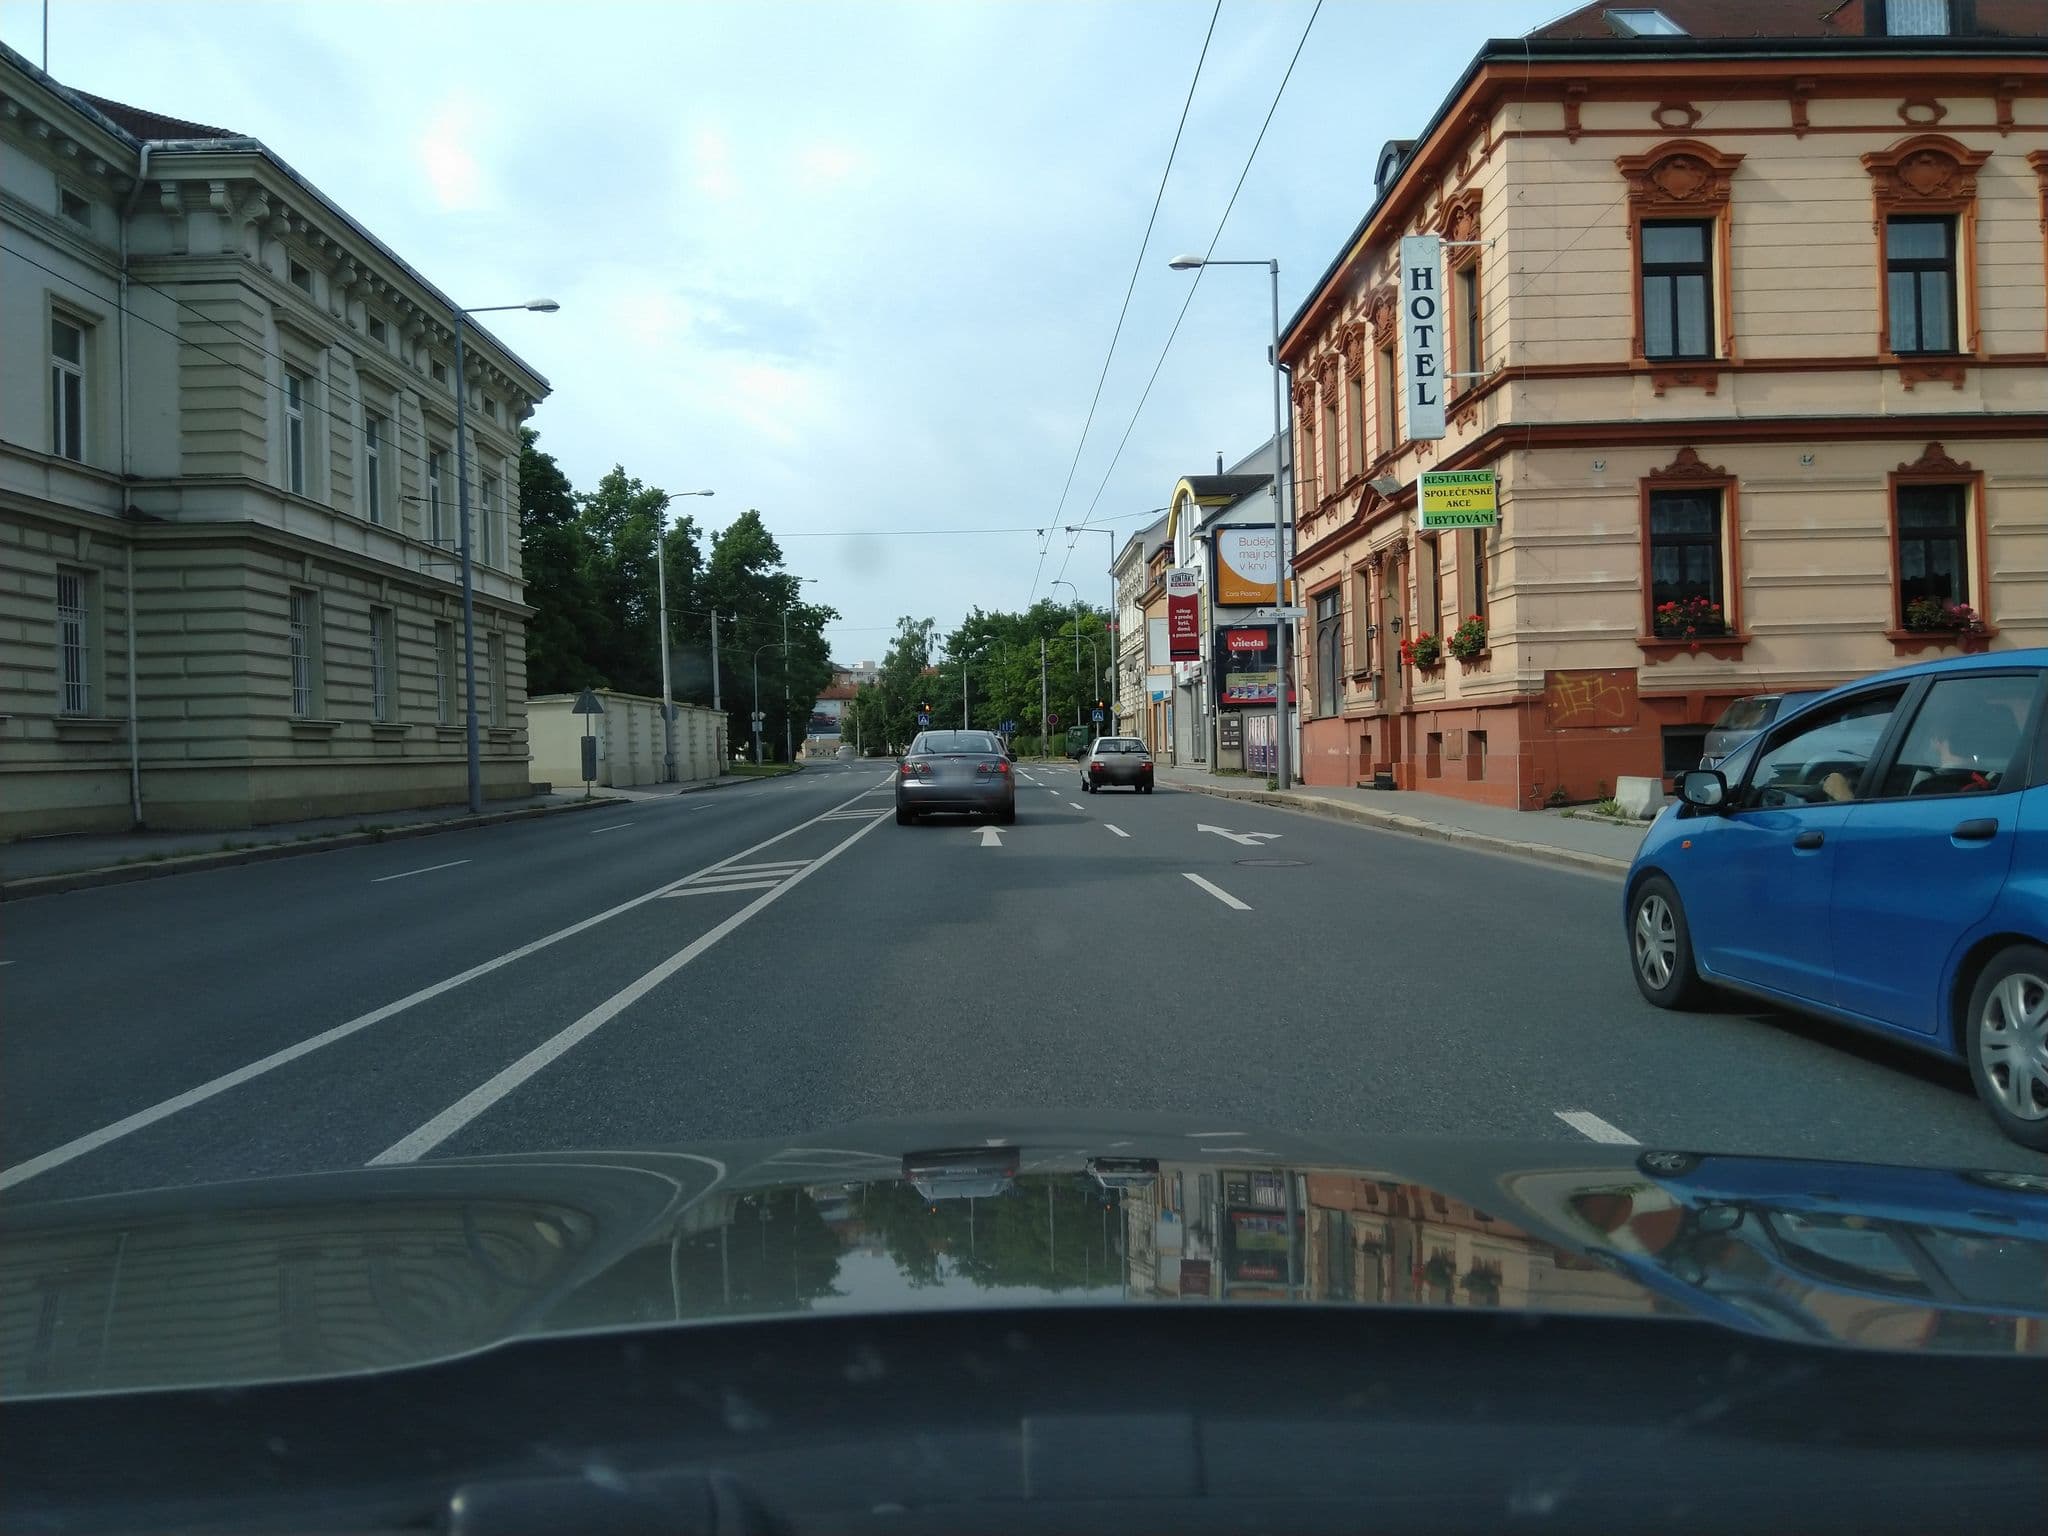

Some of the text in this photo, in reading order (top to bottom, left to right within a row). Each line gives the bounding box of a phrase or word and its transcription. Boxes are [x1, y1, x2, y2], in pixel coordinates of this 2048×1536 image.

[1410, 267, 1437, 406] HOTEL
[1424, 473, 1492, 484] RESTAURACE
[1424, 485, 1493, 498] SPOLEČENSKÉ
[1446, 499, 1472, 508] AKCE
[1426, 511, 1494, 525] UBYTOVÁNÍ
[1248, 562, 1267, 571] krvi
[1171, 574, 1194, 582] KONTAKT
[1232, 637, 1265, 647] vileda
